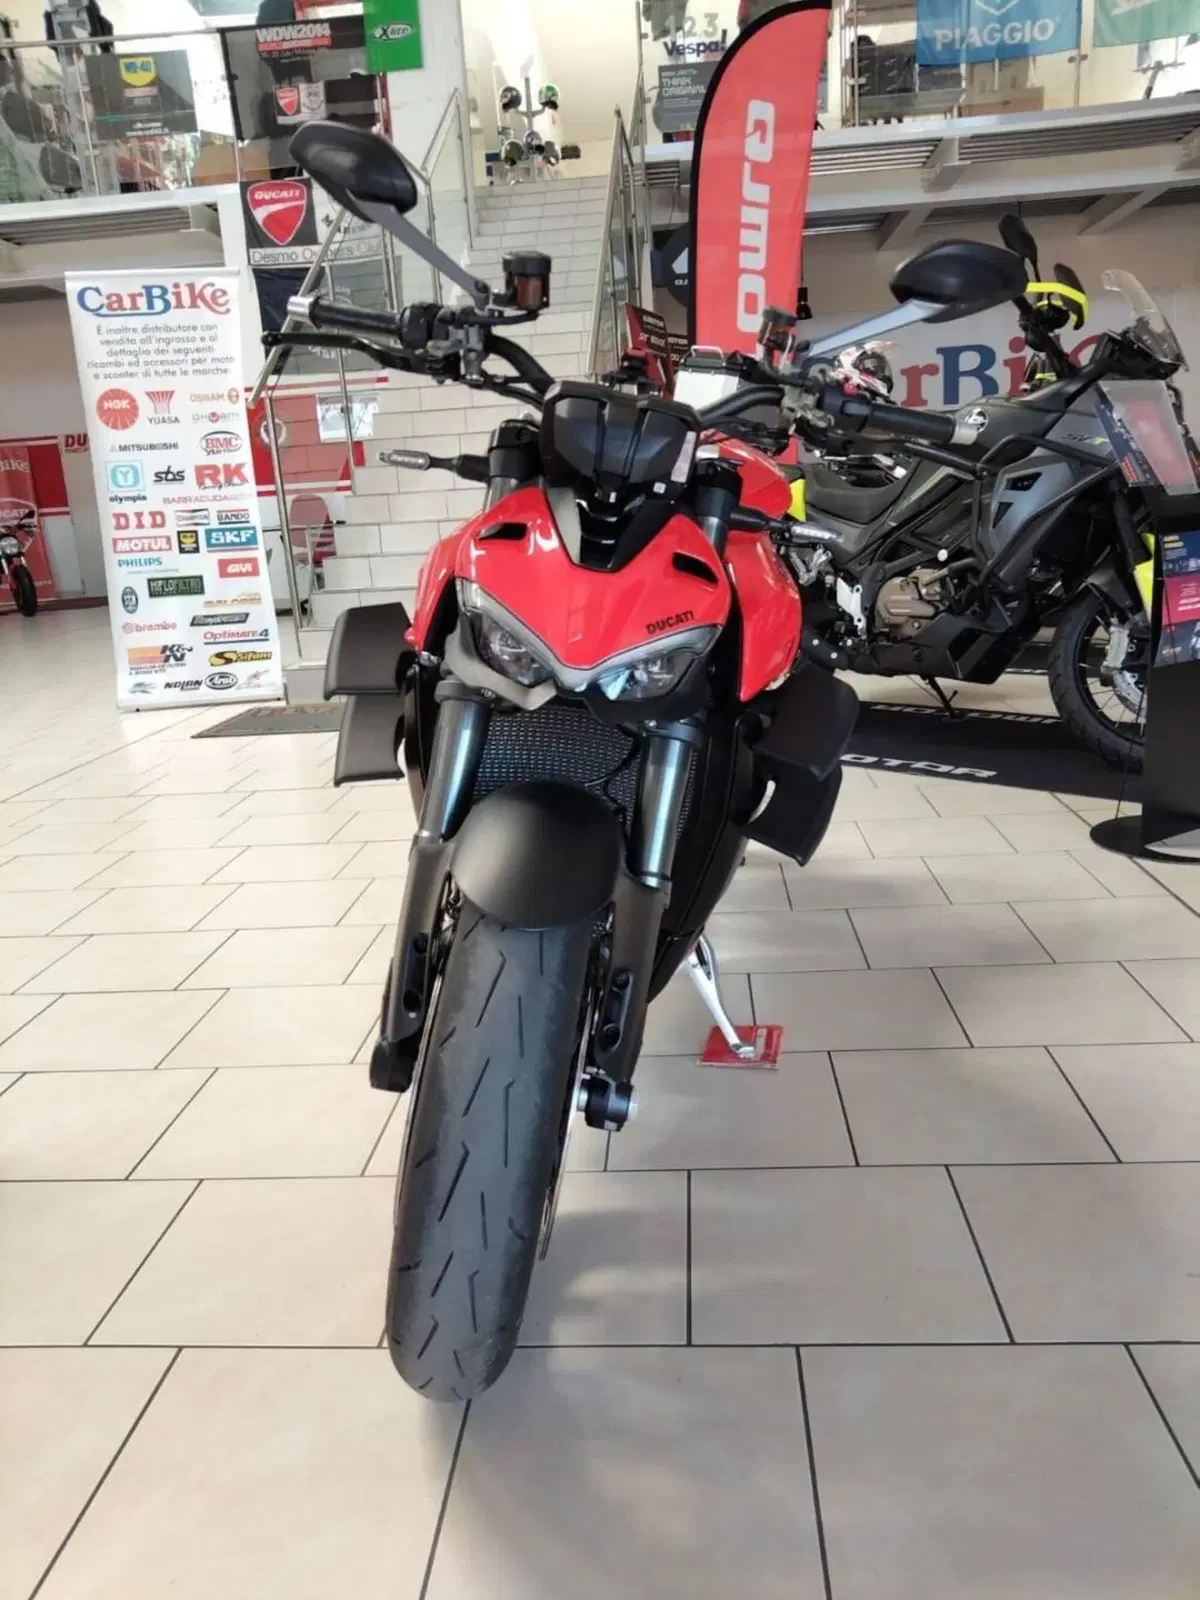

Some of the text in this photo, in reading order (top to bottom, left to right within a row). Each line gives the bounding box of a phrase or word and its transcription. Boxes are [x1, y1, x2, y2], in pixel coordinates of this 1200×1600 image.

[933, 18, 1056, 52] PIAGGIO
[254, 190, 300, 200] DUCATI
[736, 99, 776, 358] QJMO
[252, 250, 299, 263] Desmo
[77, 281, 231, 318] CarBike
[147, 416, 180, 425] YUASA
[205, 436, 238, 449] BMC
[195, 463, 249, 485] RK
[217, 512, 250, 521] BANDO
[211, 530, 254, 543] SKF
[116, 539, 170, 551] MOTUL
[118, 557, 163, 567] PHILIPS
[646, 610, 694, 635] DUCATI
